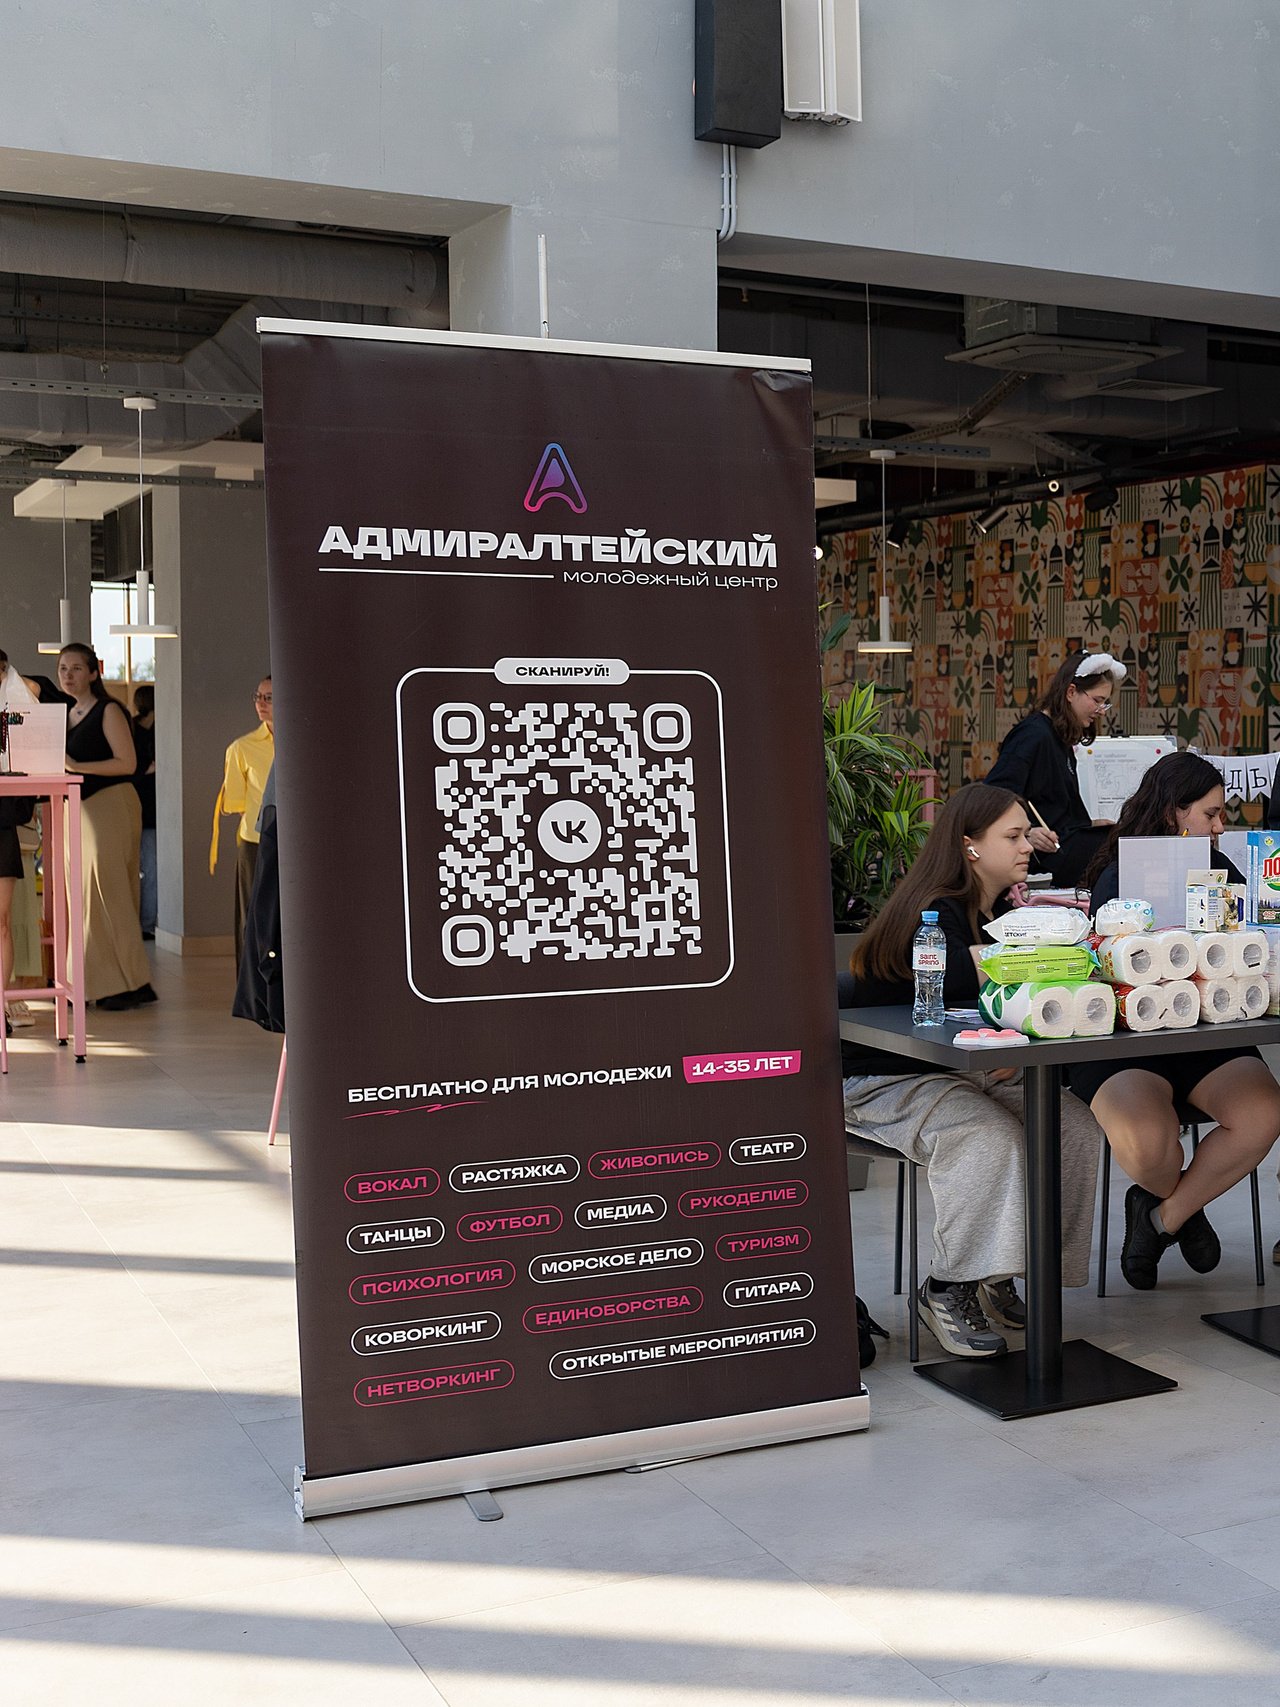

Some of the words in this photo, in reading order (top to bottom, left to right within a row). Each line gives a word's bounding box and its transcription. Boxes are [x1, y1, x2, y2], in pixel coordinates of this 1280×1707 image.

[318, 526, 777, 567] АДМИРАЛТЕЙСКИЙ
[564, 570, 708, 586] молодежный
[715, 576, 777, 591] центр
[516, 664, 610, 676] СКАНИРУЙ!
[550, 820, 590, 844] VK
[692, 1062, 750, 1076] 14-35
[754, 1056, 792, 1070] ЛЕТ
[349, 1080, 487, 1102] БЕСПЛАТНО
[492, 1076, 538, 1094] ДЛЯ
[544, 1066, 671, 1087] МОЛОДЕЖИ
[740, 1142, 794, 1156] ТЕАТР
[601, 1151, 709, 1170] ЖИВОПИСЬ
[462, 1164, 566, 1184] РАСТЯЖКА
[358, 1177, 426, 1194] ВОКАЛ
[691, 1188, 796, 1209] РУКОДЕЛИЕ
[588, 1203, 654, 1220] МЕДИА
[470, 1214, 549, 1232] ФУТБОЛ
[360, 1226, 431, 1244] ТАНЦЫ
[728, 1235, 798, 1252] ТУРИЗМ
[542, 1253, 635, 1274] МОРСКОЕ
[639, 1247, 691, 1265] ДЕЛО
[363, 1269, 502, 1295] ПСИХОЛОГИЯ
[736, 1281, 801, 1299] ГИТАРА
[536, 1295, 690, 1325] ЕДИНОБОРСТВА
[365, 1320, 487, 1346] КОВОРКИНГ
[563, 1346, 666, 1370] ОТКРЫТЫЕ
[670, 1327, 804, 1355] МЕРОПРИЯТИЯ
[368, 1369, 500, 1397] НЕТВОРКИНГ
